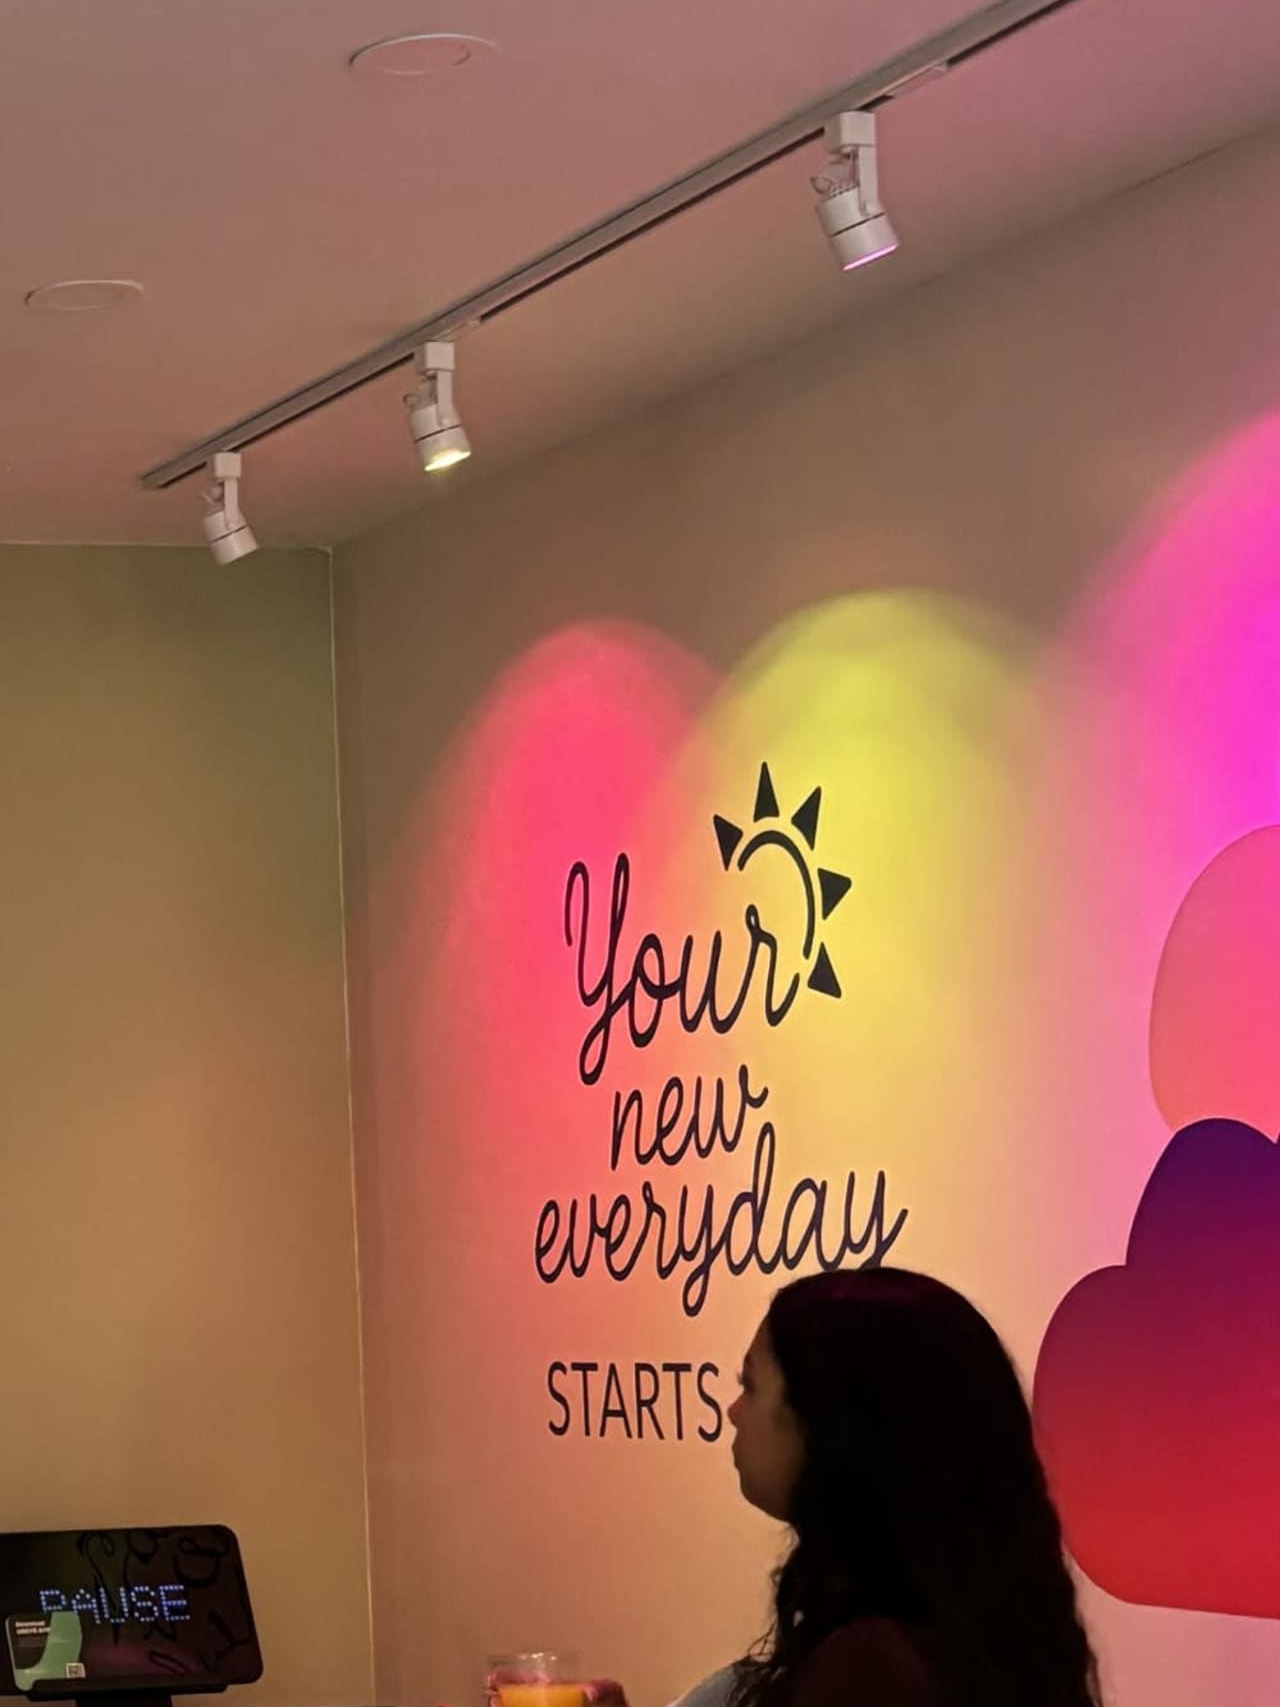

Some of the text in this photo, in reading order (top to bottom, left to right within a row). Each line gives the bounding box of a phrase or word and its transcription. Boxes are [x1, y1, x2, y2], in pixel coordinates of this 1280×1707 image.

[564, 852, 800, 1086] Your
[611, 1064, 768, 1171] new
[535, 1122, 909, 1318] everyday
[547, 1361, 723, 1442] STARTS
[39, 1584, 192, 1625] PAUSE
